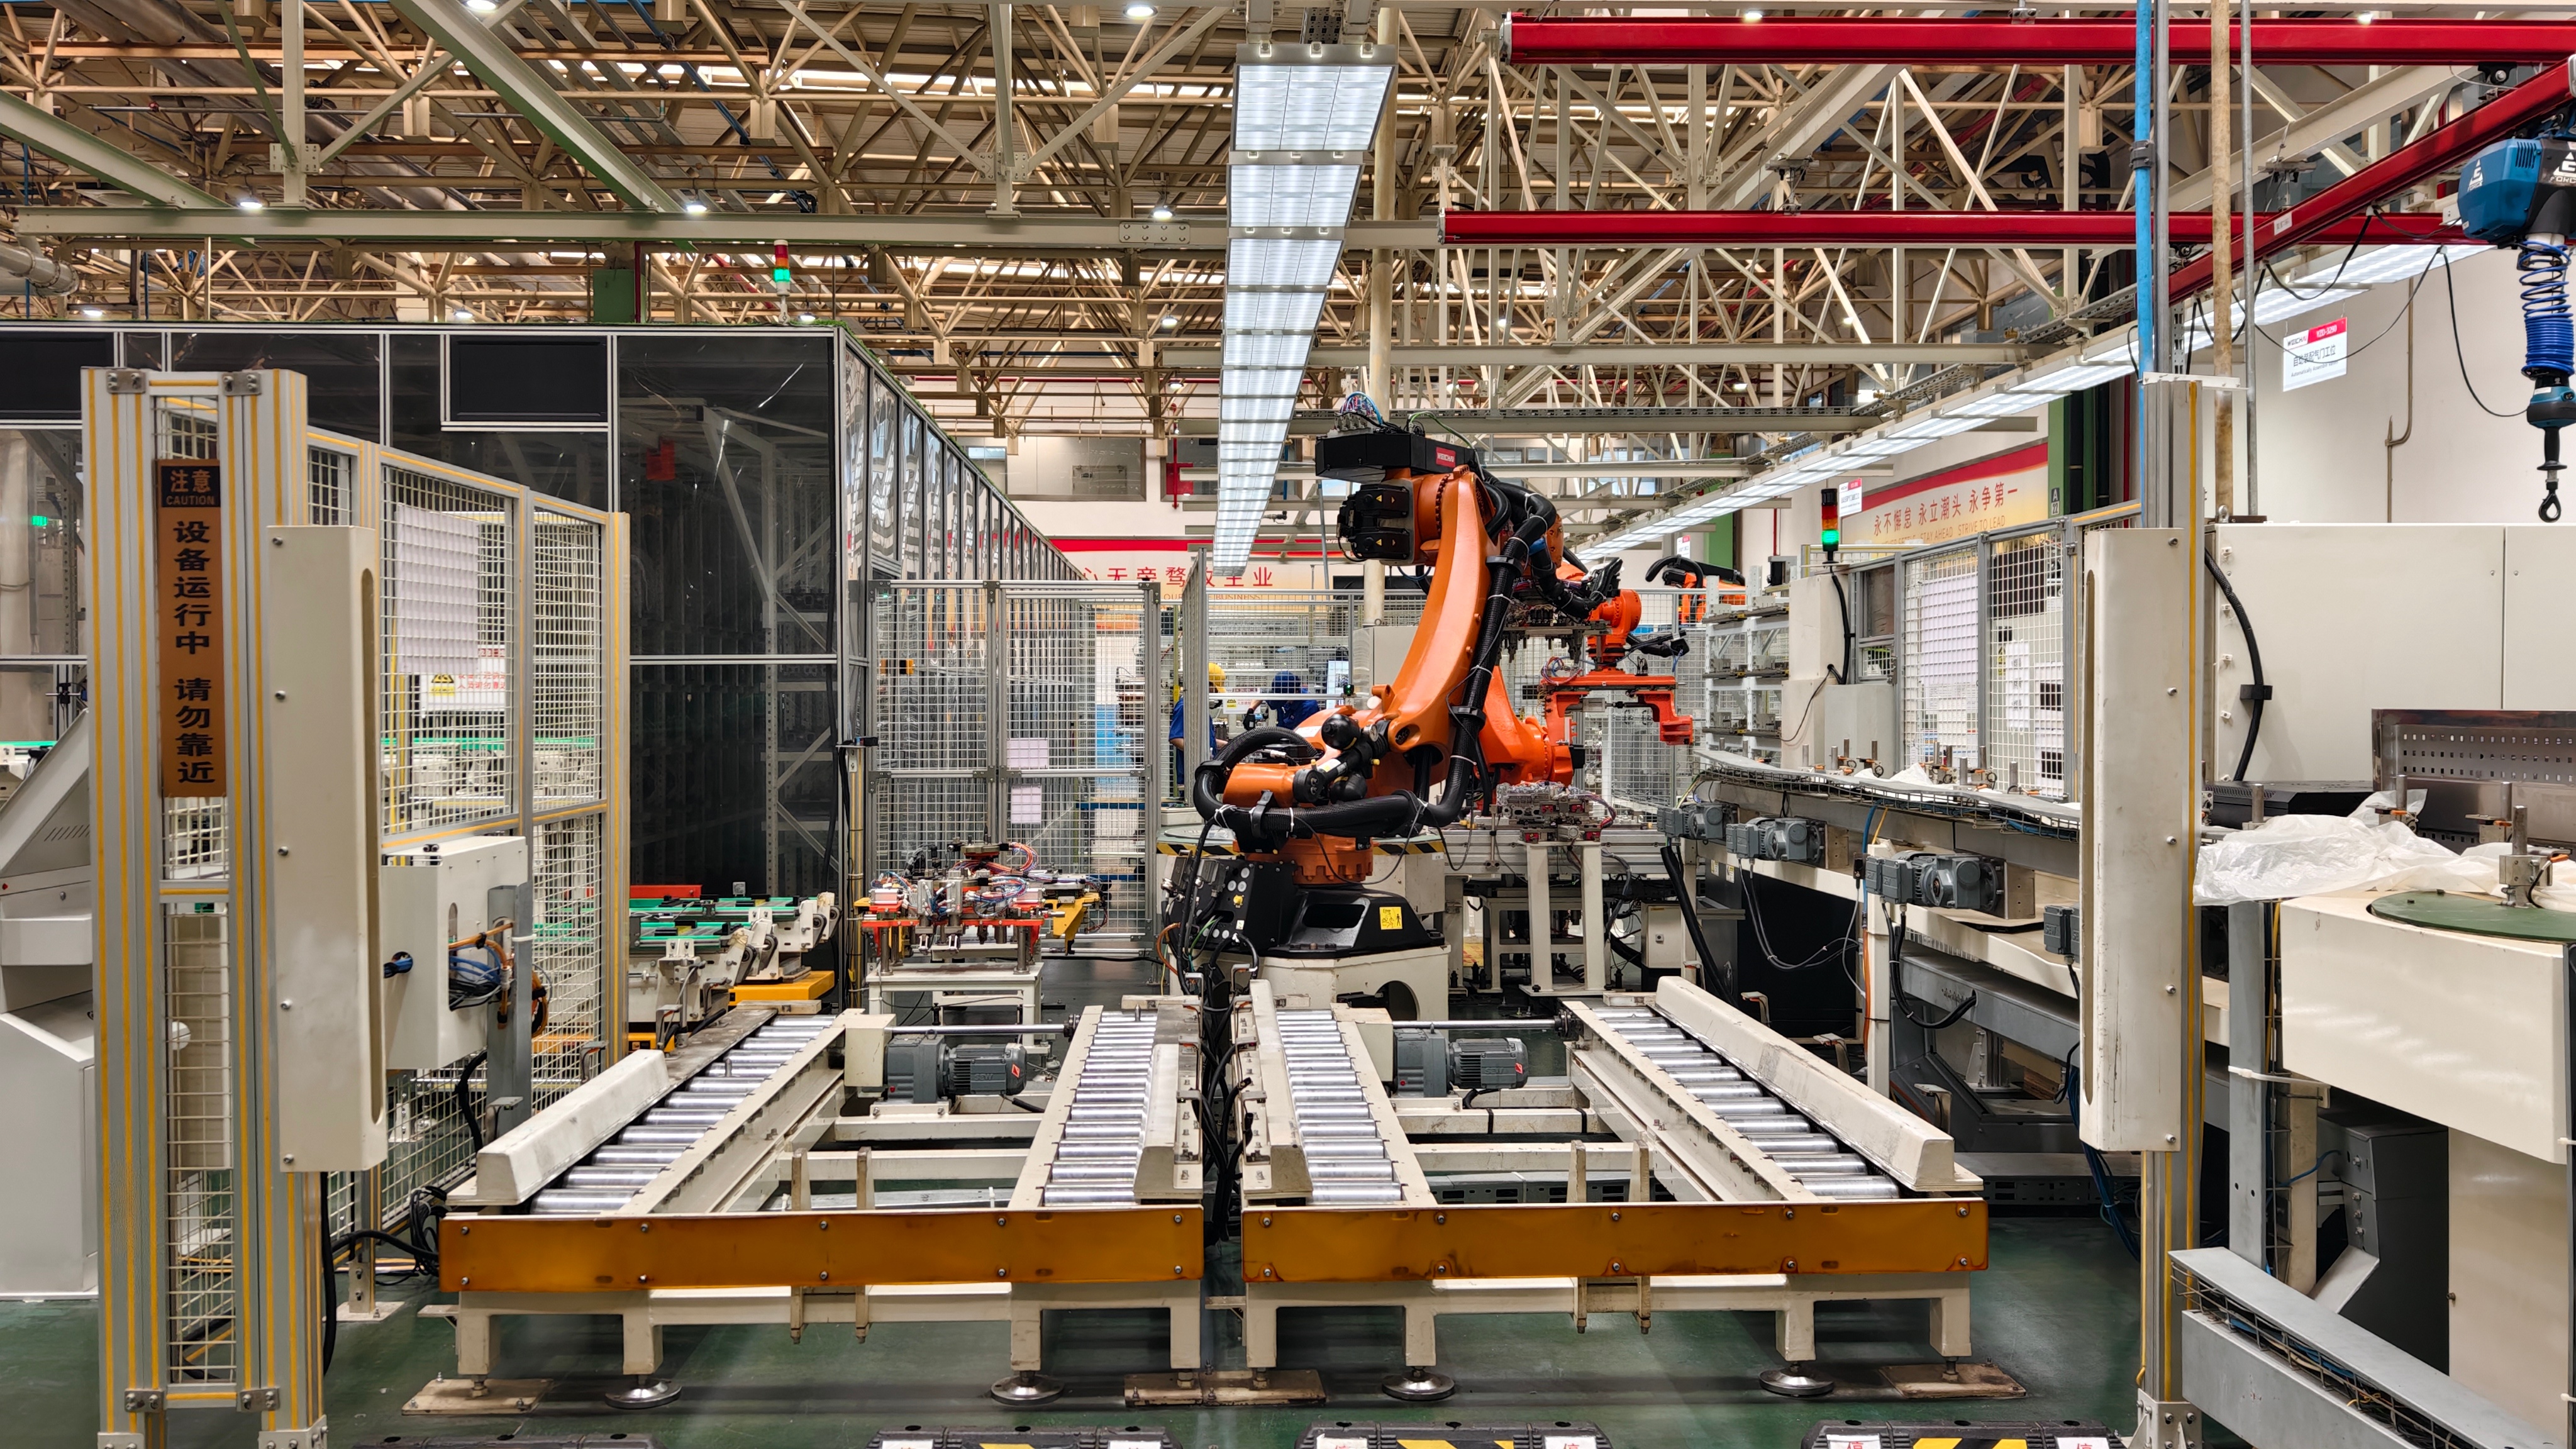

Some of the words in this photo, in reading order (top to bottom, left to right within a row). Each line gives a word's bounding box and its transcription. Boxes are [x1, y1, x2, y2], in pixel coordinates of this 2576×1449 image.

[170, 469, 211, 493] 注意
[165, 495, 215, 505] CAUTION
[2053, 489, 2058, 502] A
[1874, 507, 1912, 536] 永不懈怠
[1918, 493, 1962, 526] 永立潮头
[1969, 482, 2018, 514] 永争第一
[2053, 502, 2058, 514] 22
[1920, 530, 1934, 543] STAY
[1935, 526, 1953, 540] AHEAD
[1958, 522, 1978, 536] STRIVE
[1979, 520, 1988, 531] TO
[1989, 515, 2006, 528] LEAD
[174, 521, 213, 655] 设备运行中
[174, 677, 215, 784] 请勿靠近
[974, 1073, 994, 1081] SEW
[1484, 1067, 1504, 1075] SEW
